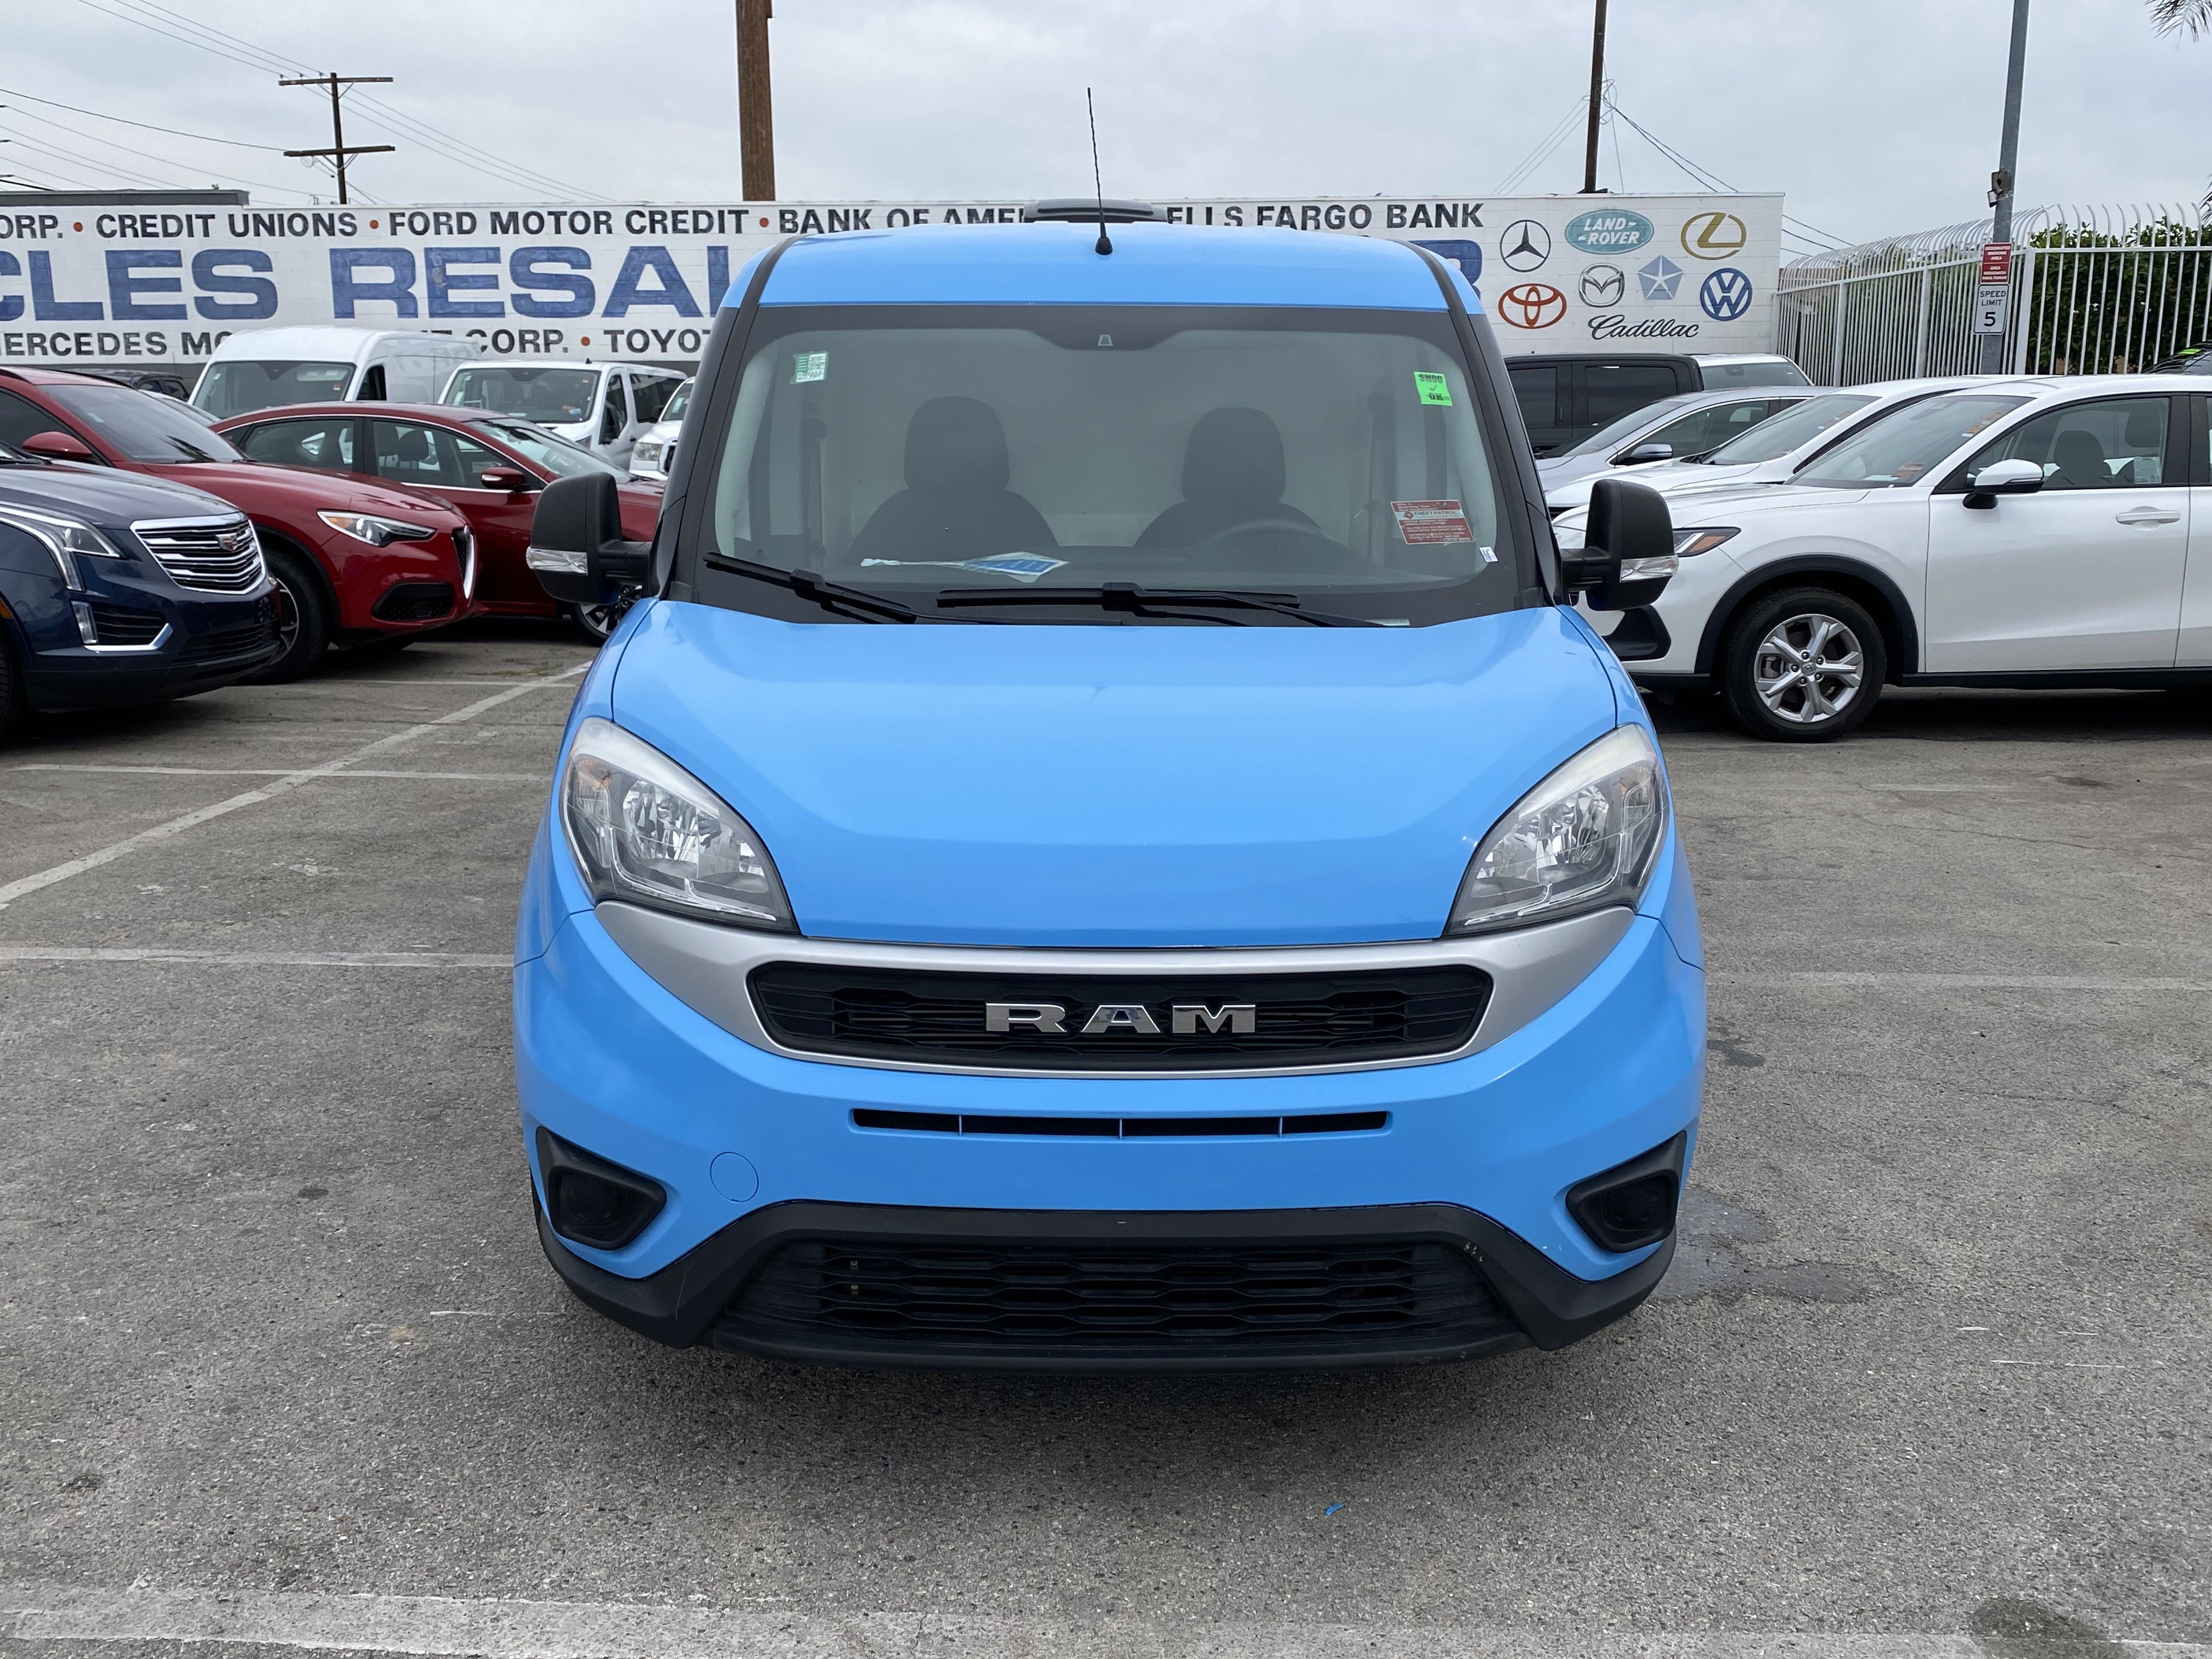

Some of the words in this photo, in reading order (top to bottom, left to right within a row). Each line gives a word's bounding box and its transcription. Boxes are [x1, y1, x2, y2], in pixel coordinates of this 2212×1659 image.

[96, 215, 215, 238] CREDIT
[228, 212, 357, 236] UNIONS
[389, 212, 477, 236] FORD
[490, 211, 613, 235] MOTOR
[625, 209, 749, 234] CREDIT
[779, 208, 872, 234] BANK
[1257, 204, 1372, 230] FARGO
[1387, 203, 1484, 228] BANK
[1588, 314, 1699, 340] Cadillac
[1984, 312, 1996, 326] 5
[1419, 374, 1443, 383] SMOG
[1429, 392, 1443, 400] OK
[985, 1003, 1256, 1033] RAM
